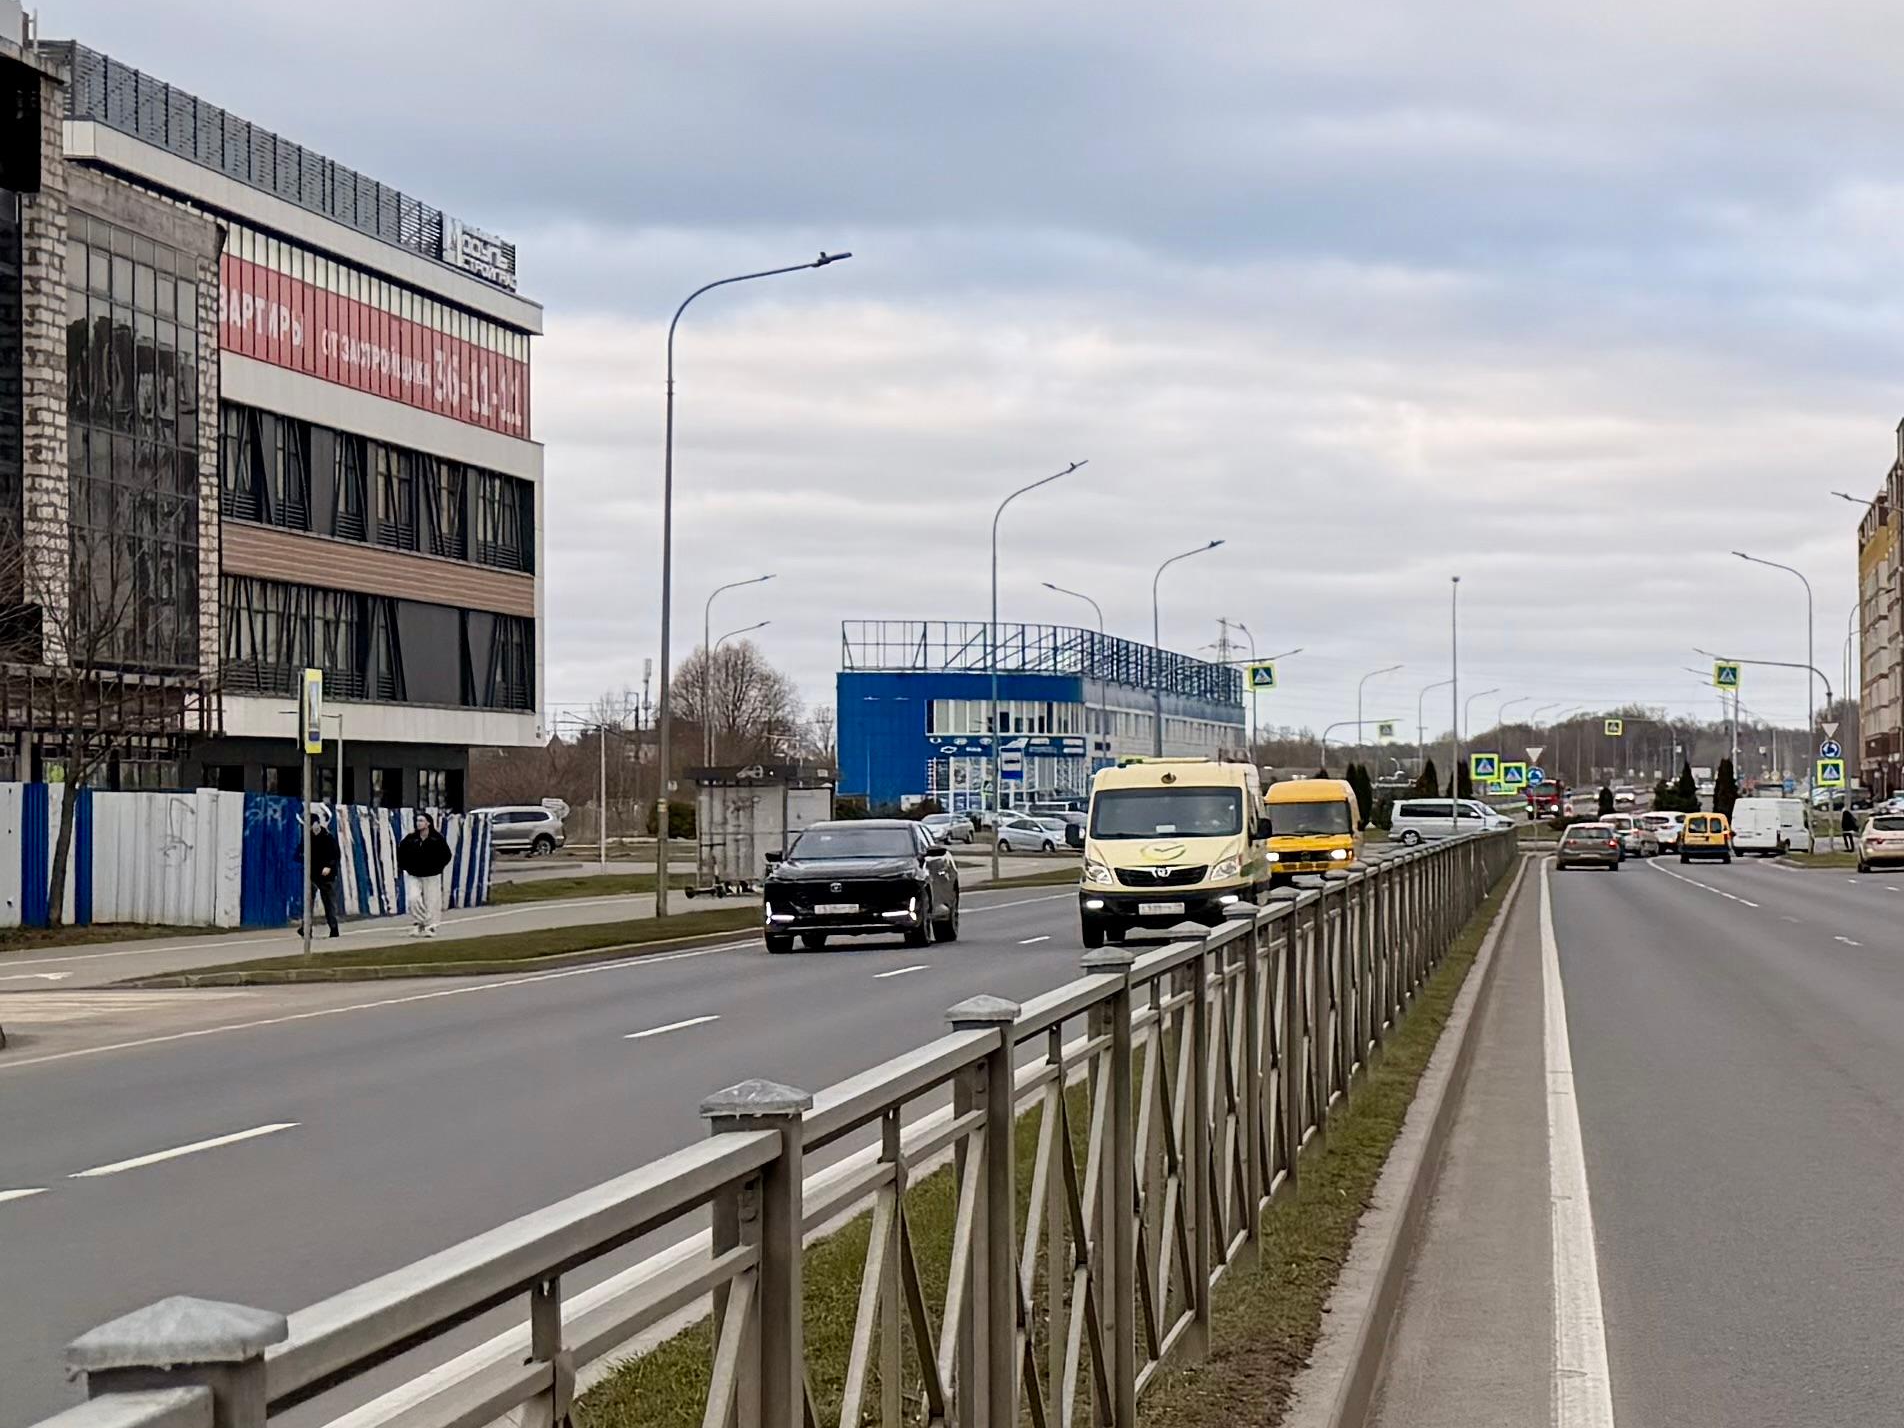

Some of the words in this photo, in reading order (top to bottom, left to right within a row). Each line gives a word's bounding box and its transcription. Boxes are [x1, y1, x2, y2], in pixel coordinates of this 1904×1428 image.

[322, 329, 338, 358] ОТ
[342, 334, 431, 388] ЗАСТРОЙЩИКА
[434, 348, 522, 427] 36-11-11
